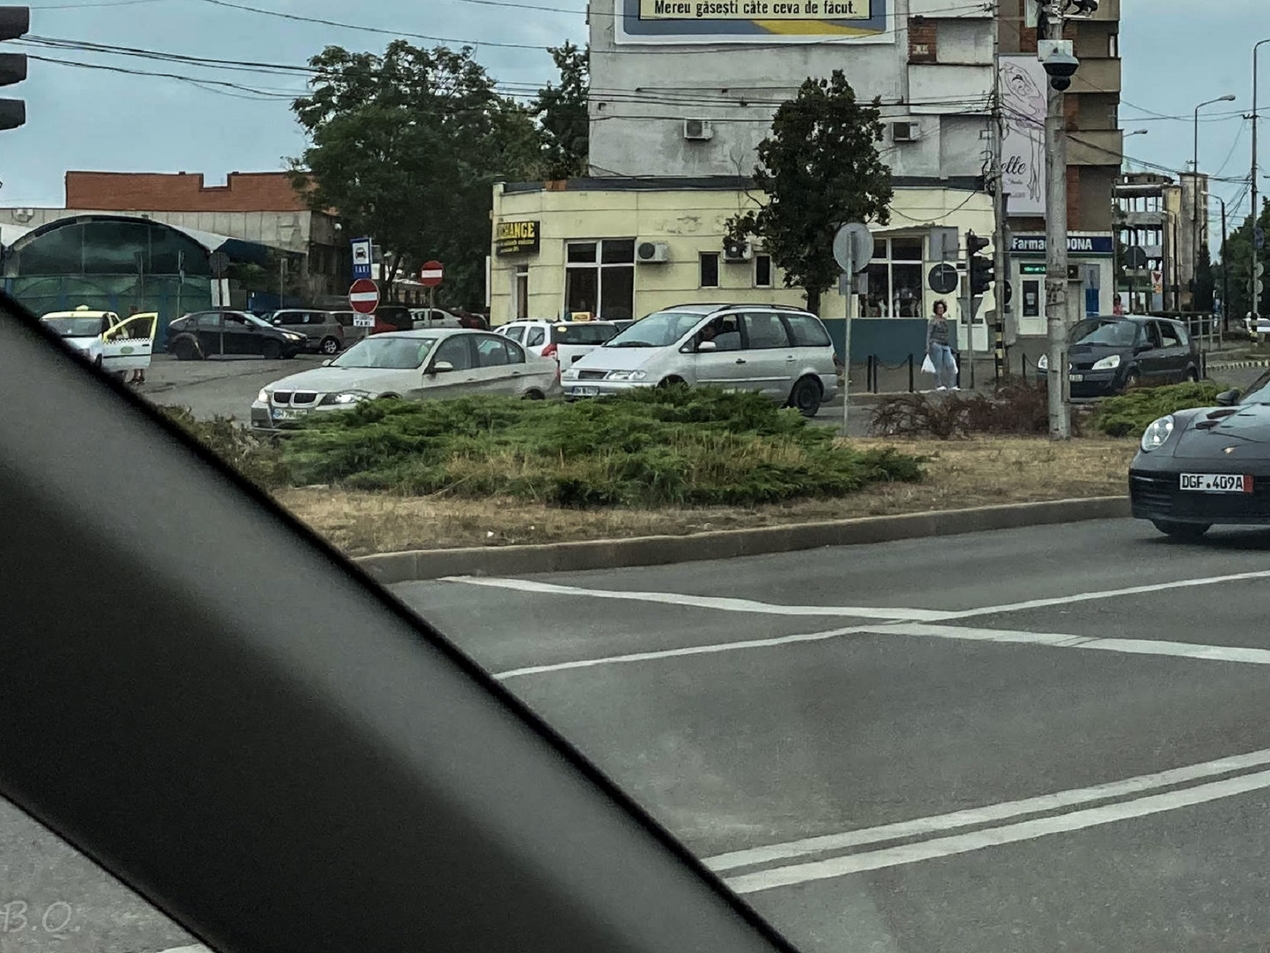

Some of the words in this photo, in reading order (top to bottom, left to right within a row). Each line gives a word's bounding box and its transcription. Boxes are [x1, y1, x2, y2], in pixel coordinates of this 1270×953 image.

[654, 0, 691, 15] Mereu
[696, 0, 739, 18] găsești
[743, 0, 769, 15] câte
[773, 1, 800, 15] ceva
[804, 0, 819, 15] de
